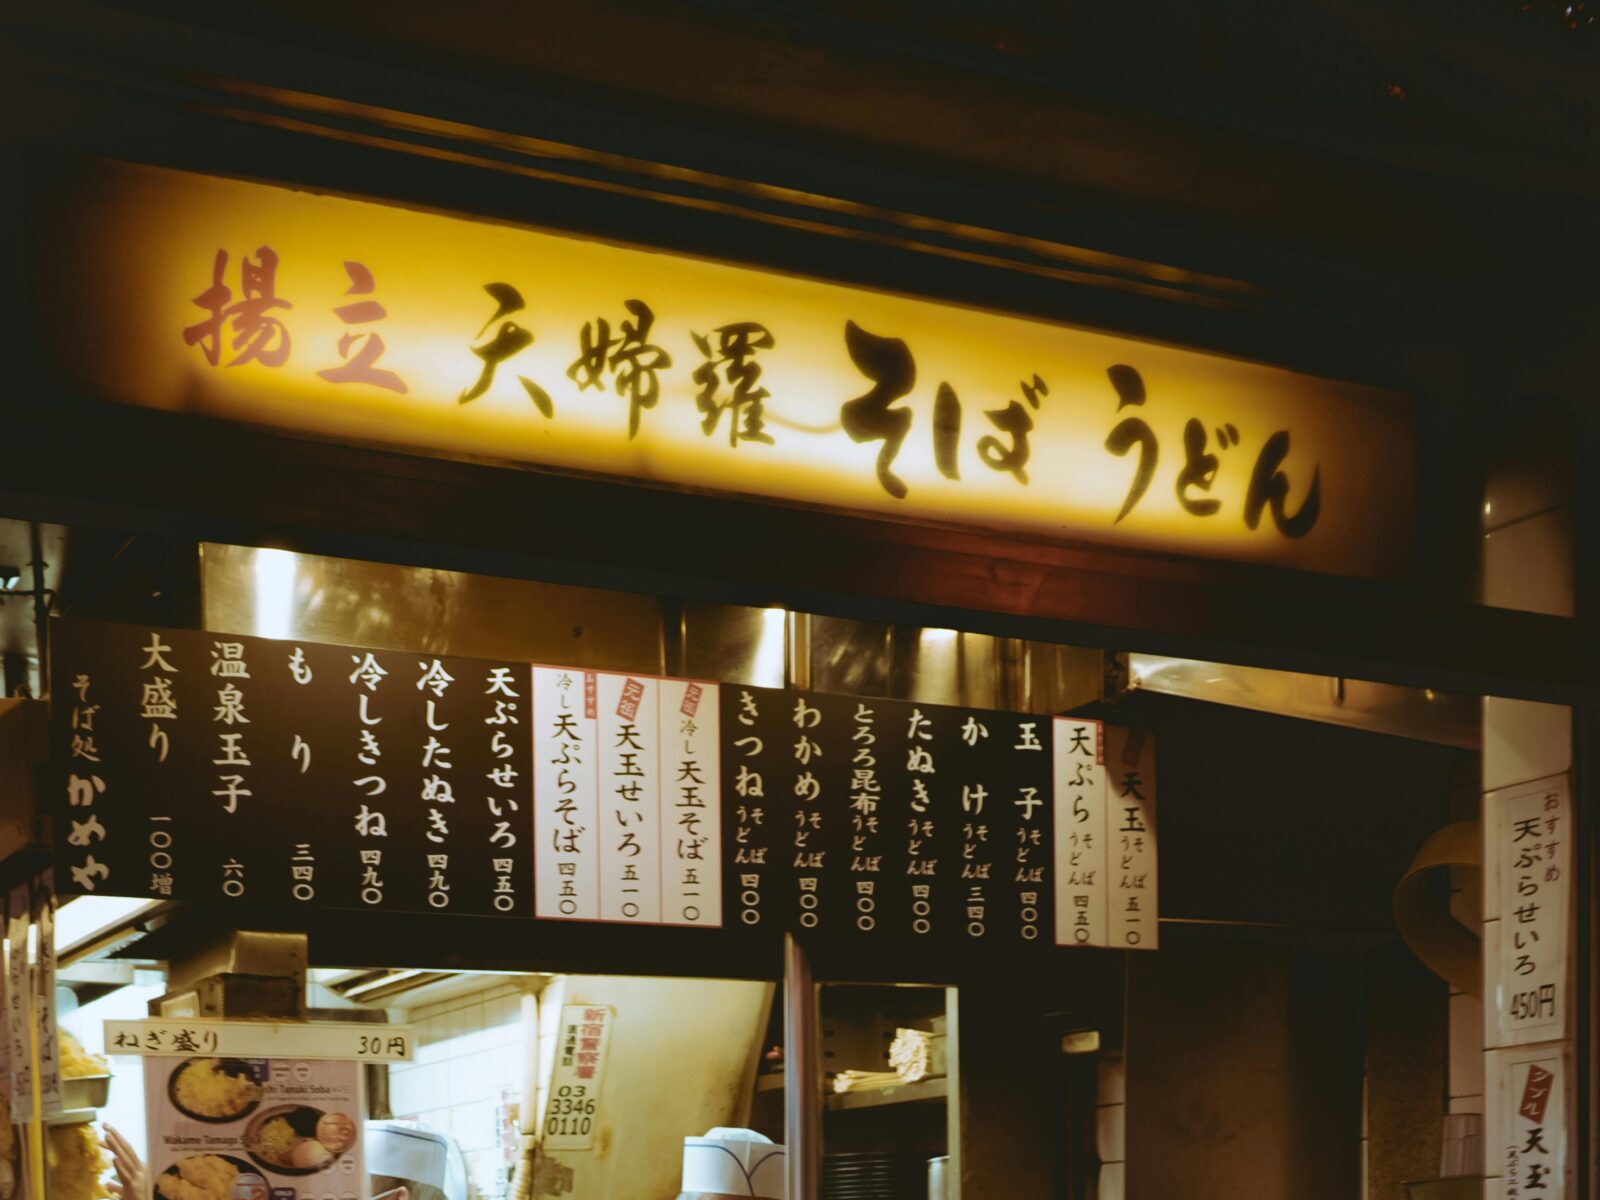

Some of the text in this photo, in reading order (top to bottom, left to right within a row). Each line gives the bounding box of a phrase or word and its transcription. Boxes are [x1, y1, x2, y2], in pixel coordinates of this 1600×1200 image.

[182, 245, 1322, 539] 揚立 天婦羅 そば うどん
[140, 632, 179, 763] 大盛り
[210, 640, 252, 814] 温泉玉子
[348, 652, 389, 838] 冷しきつね
[733, 690, 765, 798] きつね
[792, 698, 823, 800] わかめ
[416, 659, 456, 844] 冷したぬき
[484, 667, 521, 849] 天ぷらせいろ
[613, 723, 646, 858] 天玉せいろ
[849, 703, 882, 815] とろろ昆布
[906, 708, 936, 813] たぬき
[961, 716, 989, 816] かけ
[1014, 722, 1044, 821] 玉子
[1067, 725, 1094, 824] 天ぷら
[1120, 771, 1147, 833] 天玉
[1544, 790, 1561, 883] おすすめ
[1512, 817, 1542, 977] 天ぷらせいろ
[114, 1029, 406, 1057] ねぎ盛り 30円
[1509, 982, 1556, 1021] 450円
[547, 1116, 592, 1136] 0110
[551, 1098, 596, 1115] 3346
[557, 1085, 587, 1098] 03
